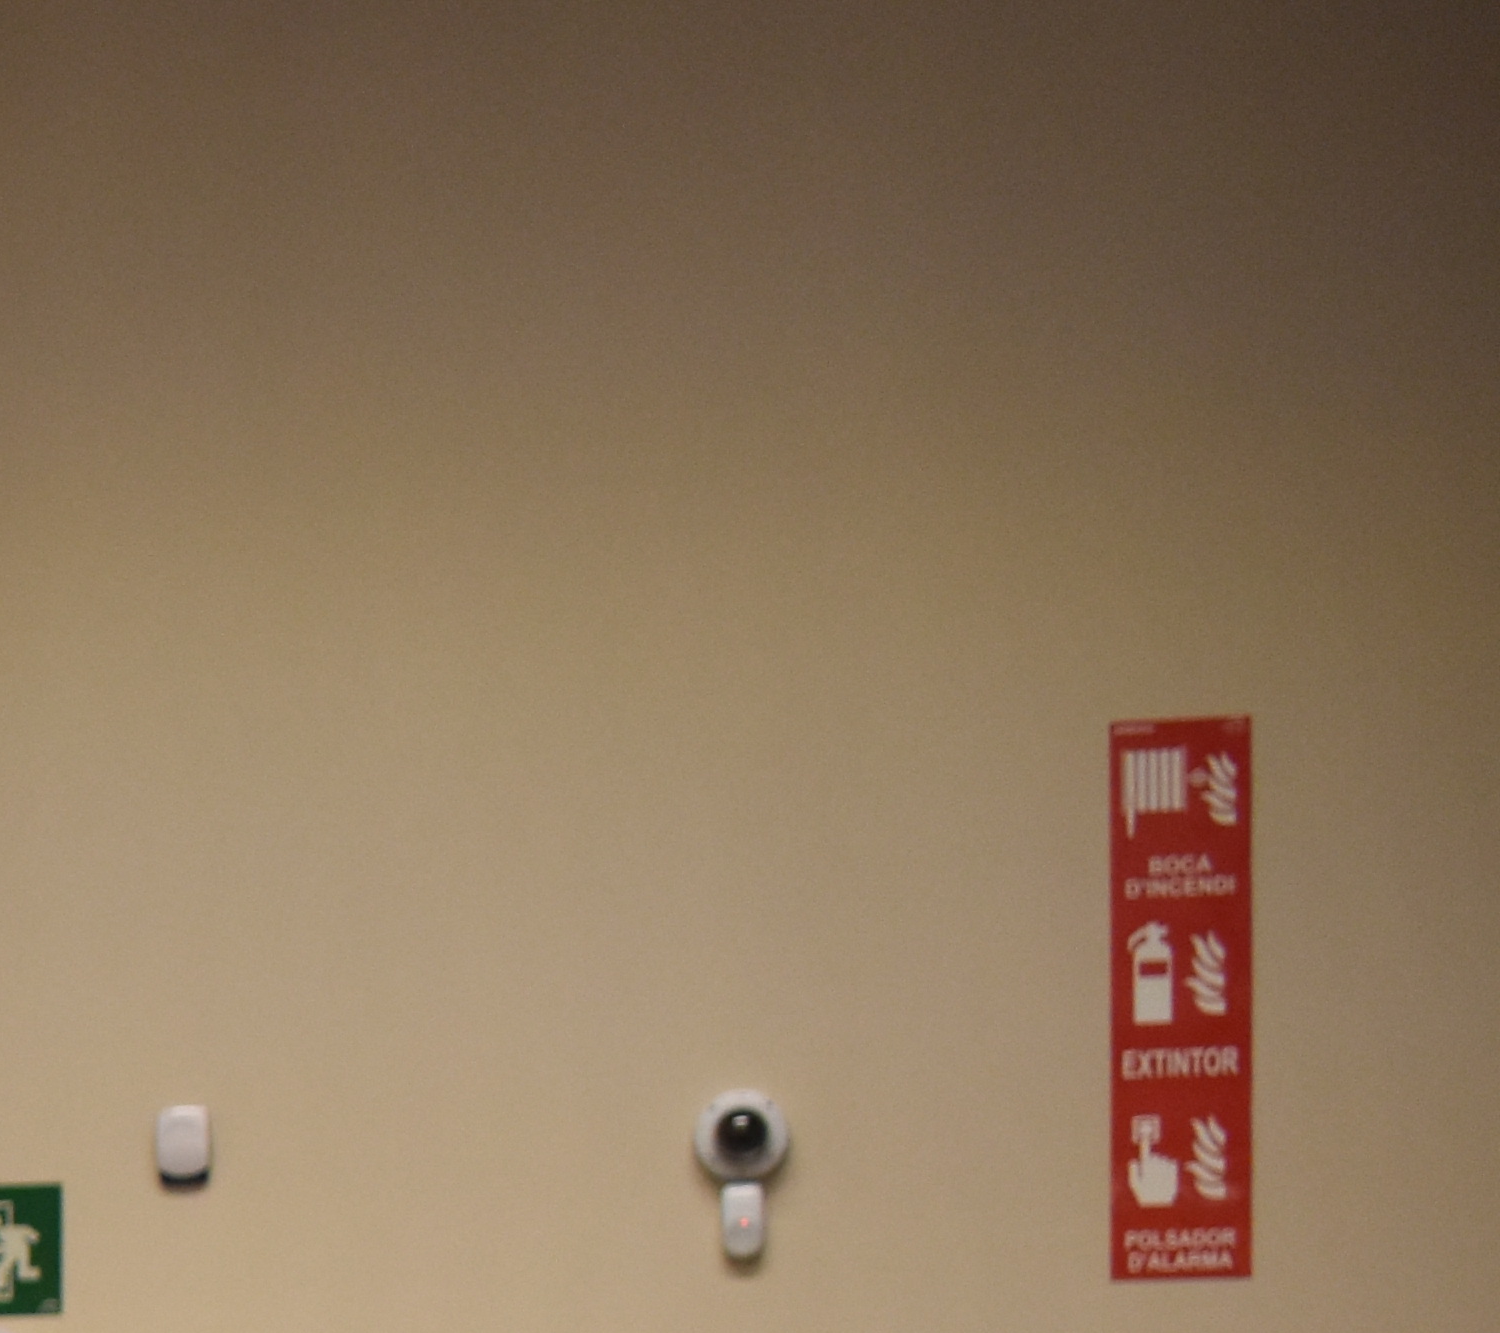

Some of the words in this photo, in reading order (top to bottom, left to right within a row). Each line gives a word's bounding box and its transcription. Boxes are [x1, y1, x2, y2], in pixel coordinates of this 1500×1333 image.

[1148, 853, 1212, 875] BOCA
[1124, 875, 1236, 900] D'INCENDI
[1122, 1047, 1239, 1079] EXTINTOR
[1124, 1228, 1236, 1251] POLSADOR
[1127, 1250, 1233, 1273] D'ALARMA
